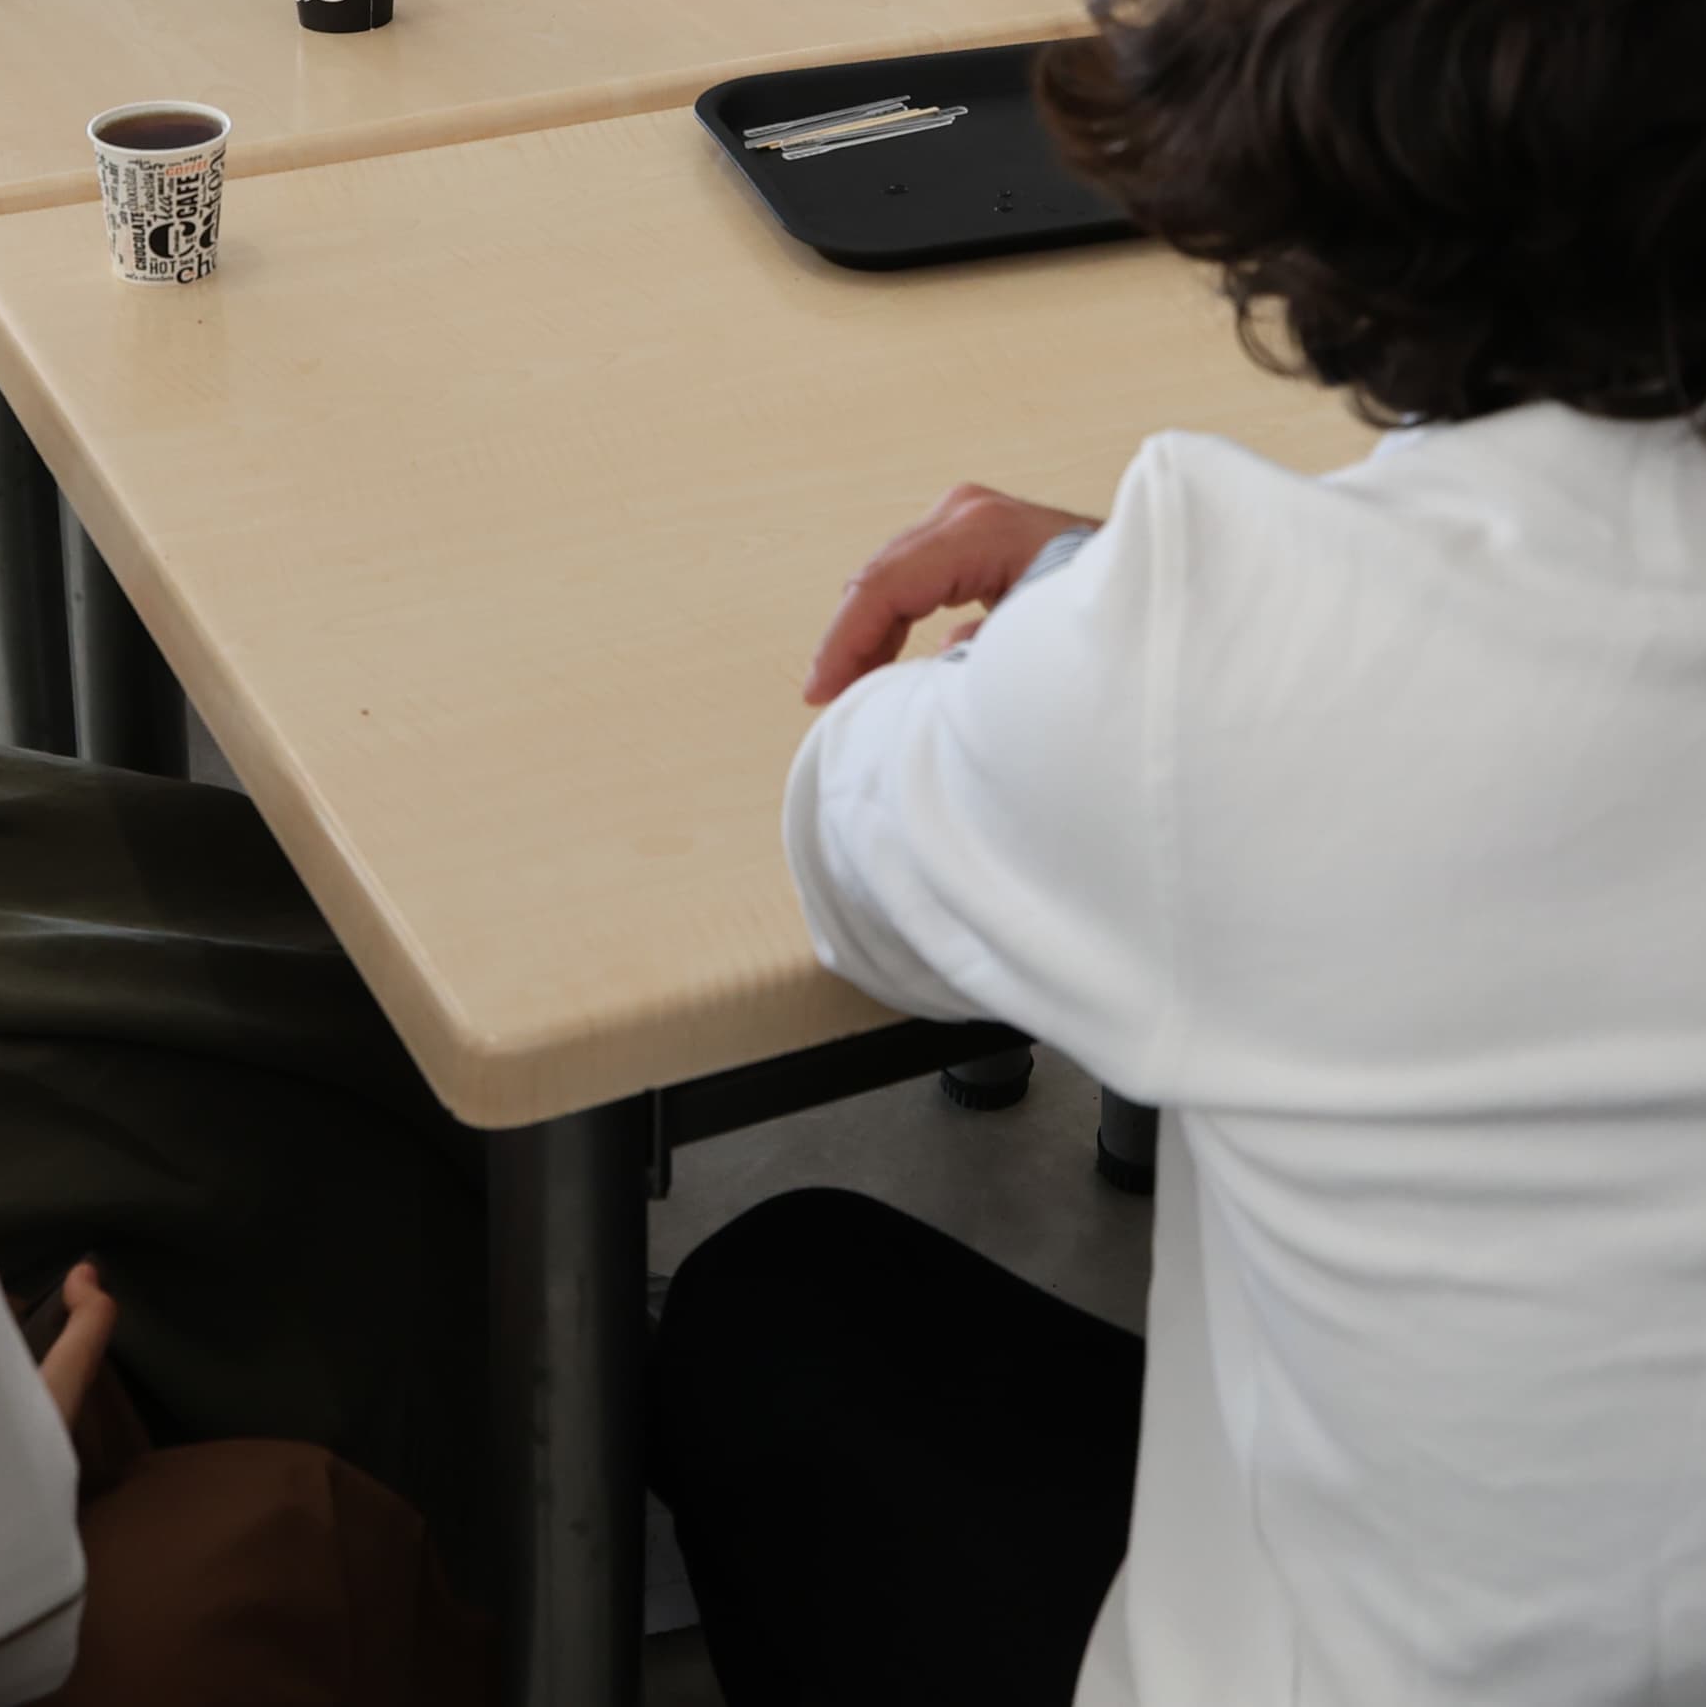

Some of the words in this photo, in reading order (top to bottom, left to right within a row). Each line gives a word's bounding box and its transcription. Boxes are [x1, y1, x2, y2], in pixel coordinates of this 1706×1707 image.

[176, 173, 200, 219] CAFE
[131, 211, 147, 271] CHOCOLATE
[149, 260, 177, 275] HOT
